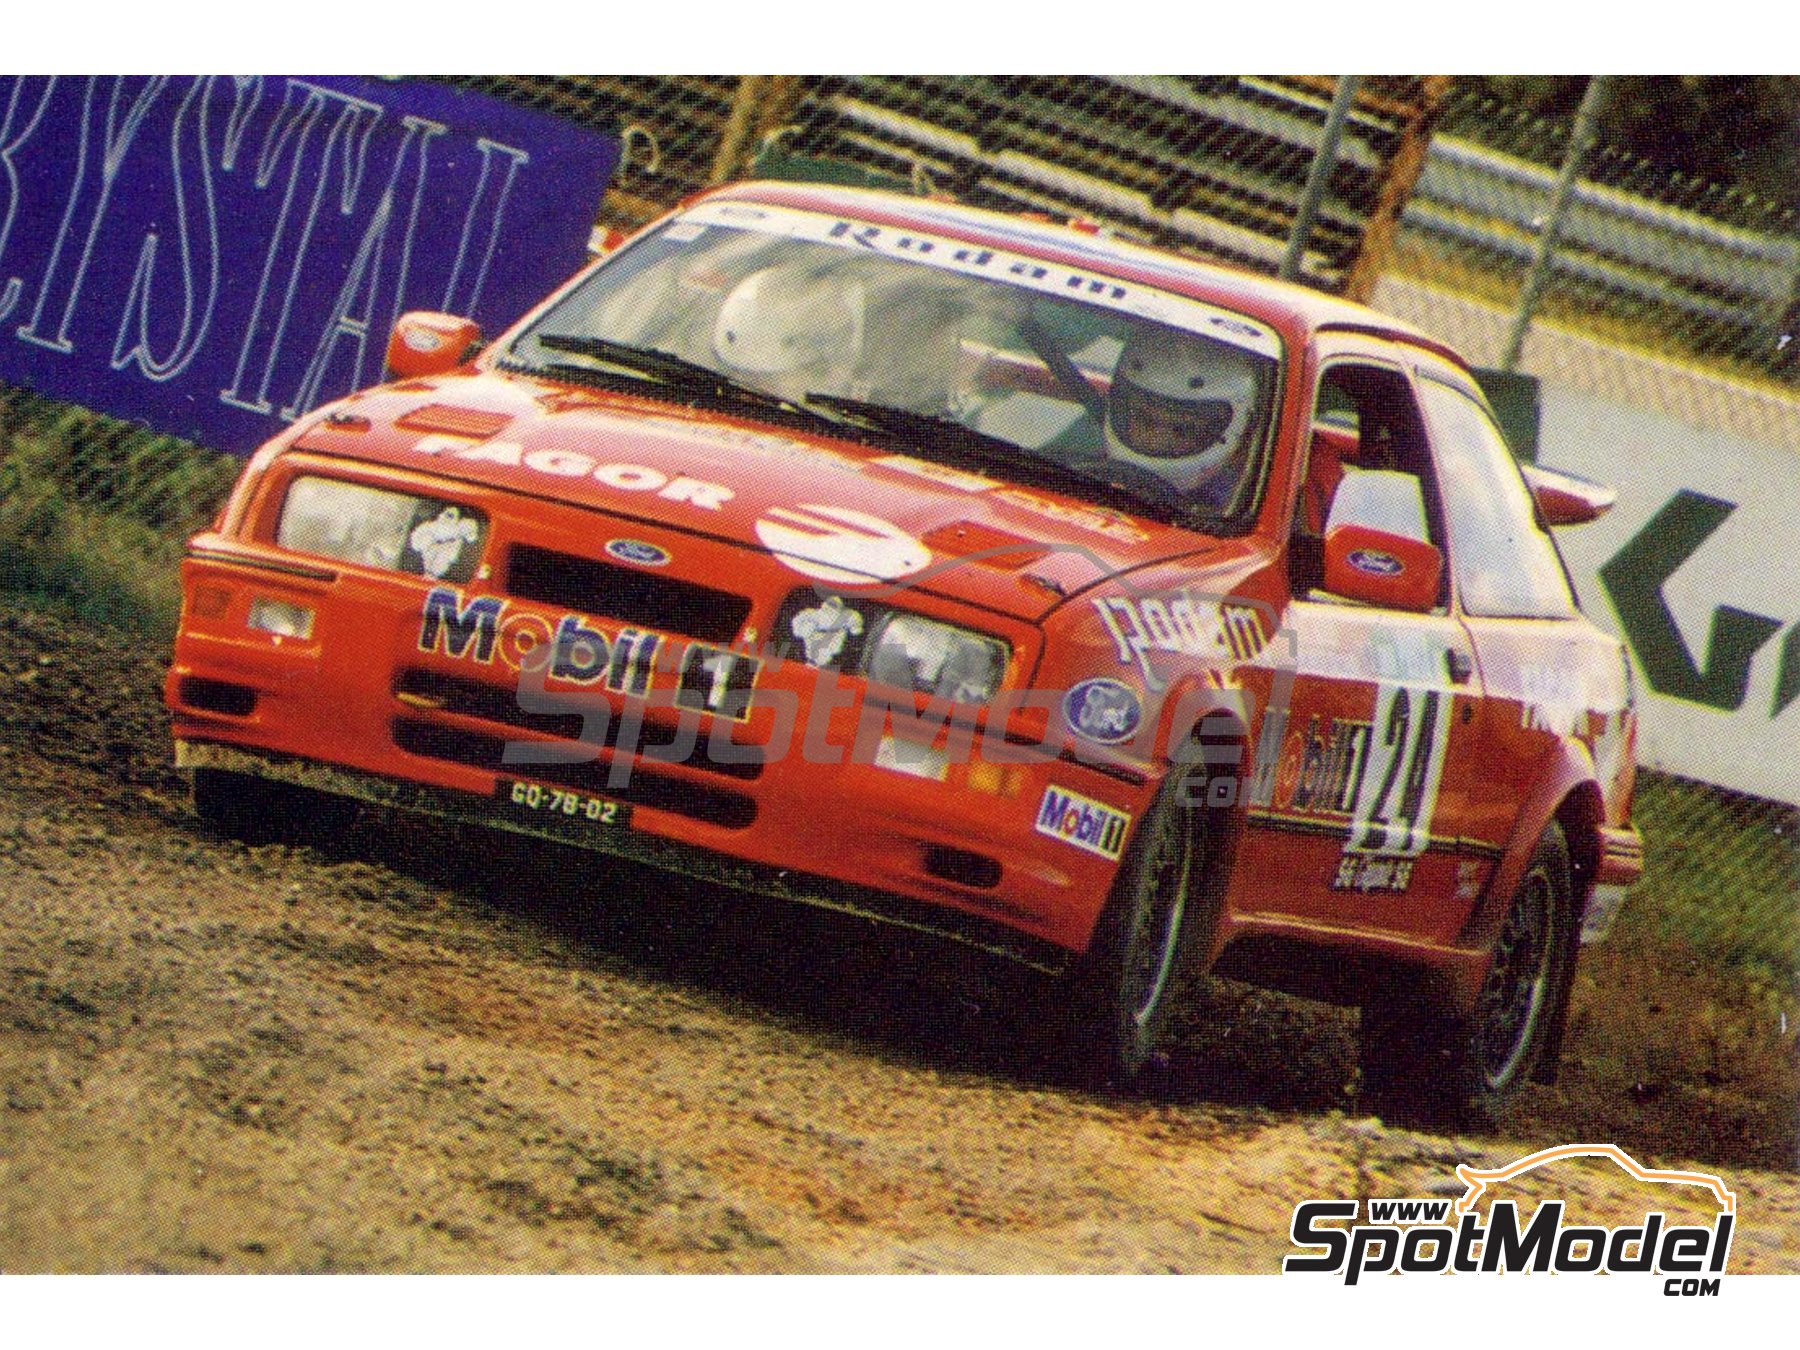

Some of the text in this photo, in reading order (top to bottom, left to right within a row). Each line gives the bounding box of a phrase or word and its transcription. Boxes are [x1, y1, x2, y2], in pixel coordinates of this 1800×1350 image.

[828, 219, 1127, 300] Rodam
[411, 434, 736, 511] FAGOR
[417, 586, 662, 699] Mobil
